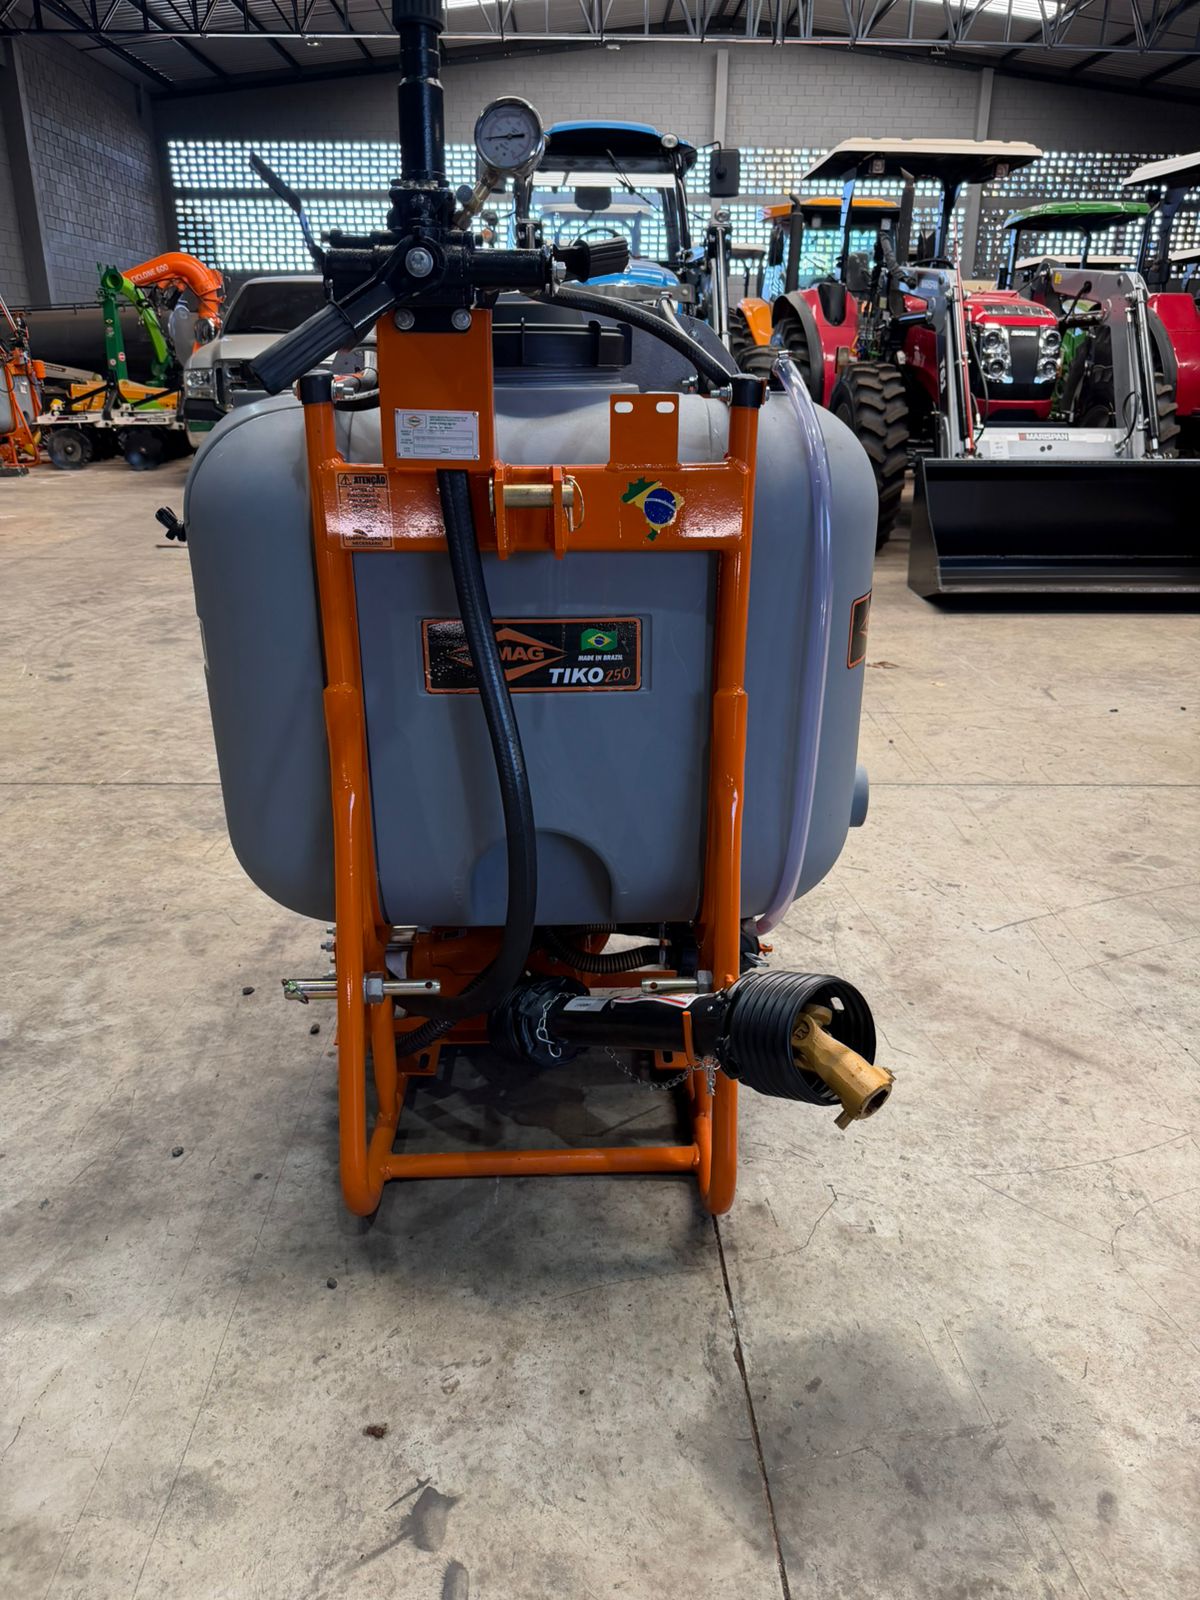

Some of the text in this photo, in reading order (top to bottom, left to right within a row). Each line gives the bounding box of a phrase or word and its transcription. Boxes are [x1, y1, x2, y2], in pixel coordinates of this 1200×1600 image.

[155, 263, 169, 274] 600
[353, 474, 386, 485] ATENÇÃO
[499, 646, 545, 661] MAG
[577, 653, 623, 662] MADE IN BRAZIL
[549, 666, 631, 684] TIKO 250
